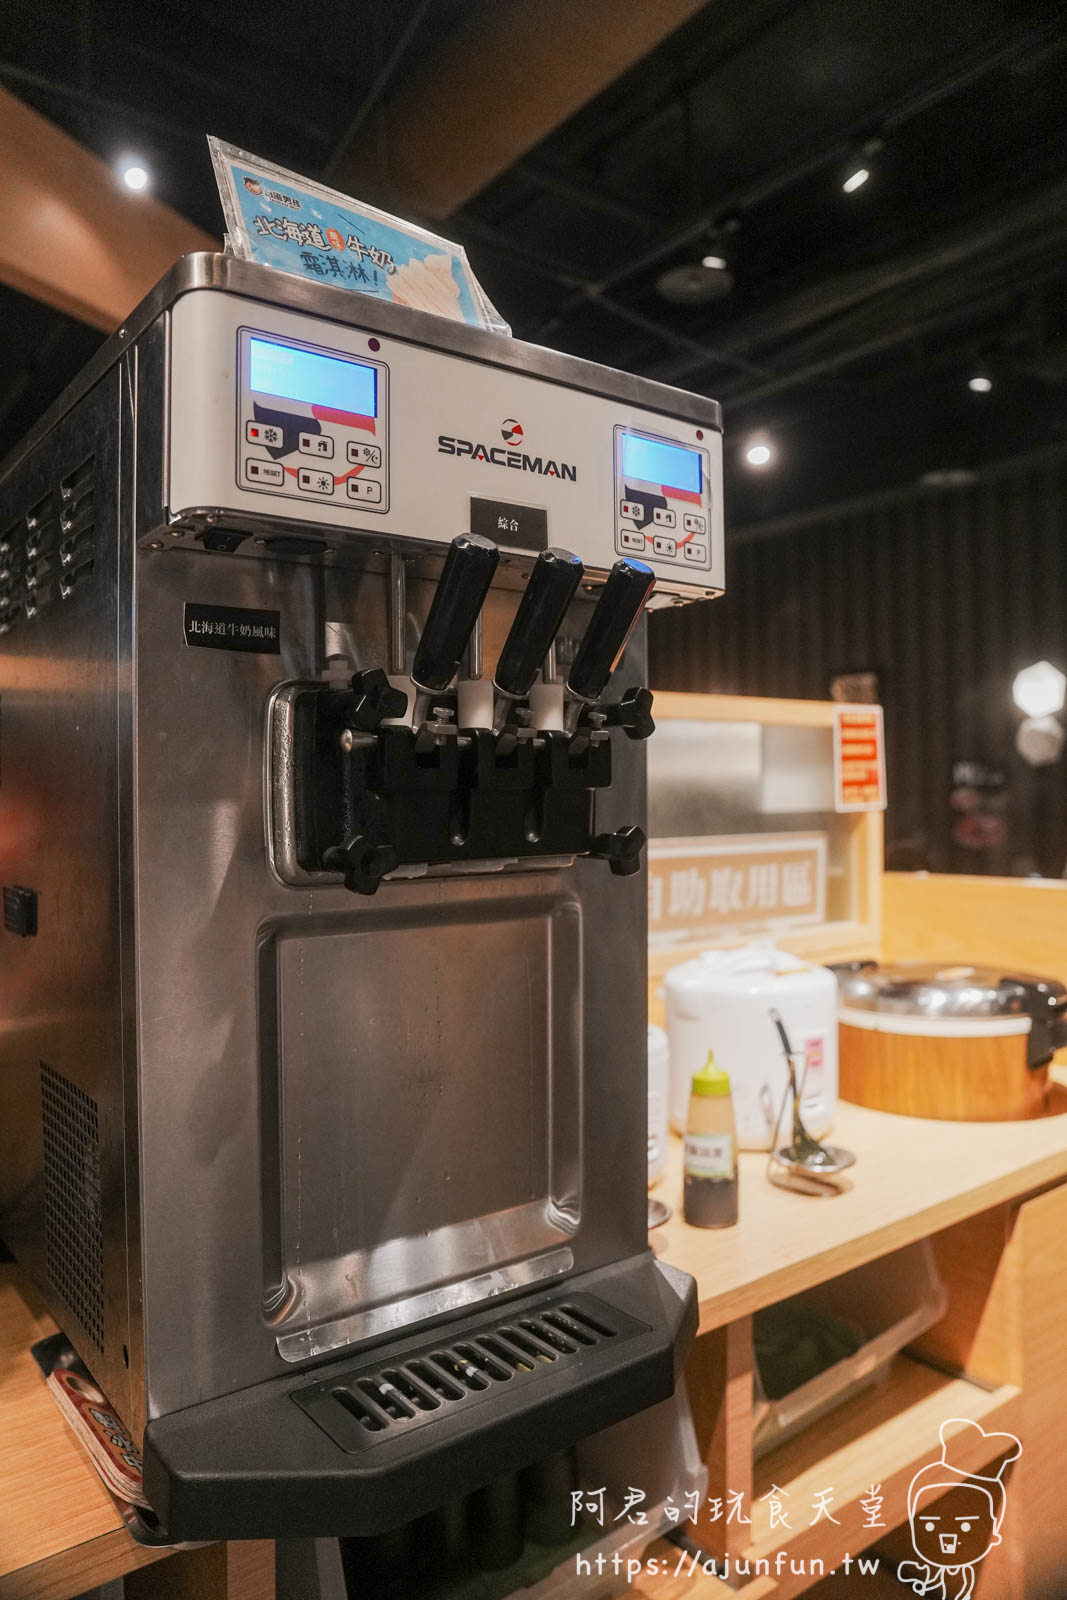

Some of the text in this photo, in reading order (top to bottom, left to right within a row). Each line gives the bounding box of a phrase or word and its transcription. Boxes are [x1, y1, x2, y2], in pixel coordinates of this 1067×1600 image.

[253, 215, 398, 276] 北海道 風味 牛奶
[438, 435, 577, 482] SPACEMAN
[263, 468, 281, 478] RESET
[366, 486, 373, 495] P
[497, 516, 519, 532] 綜合
[189, 619, 276, 639] 北海道牛奶風味
